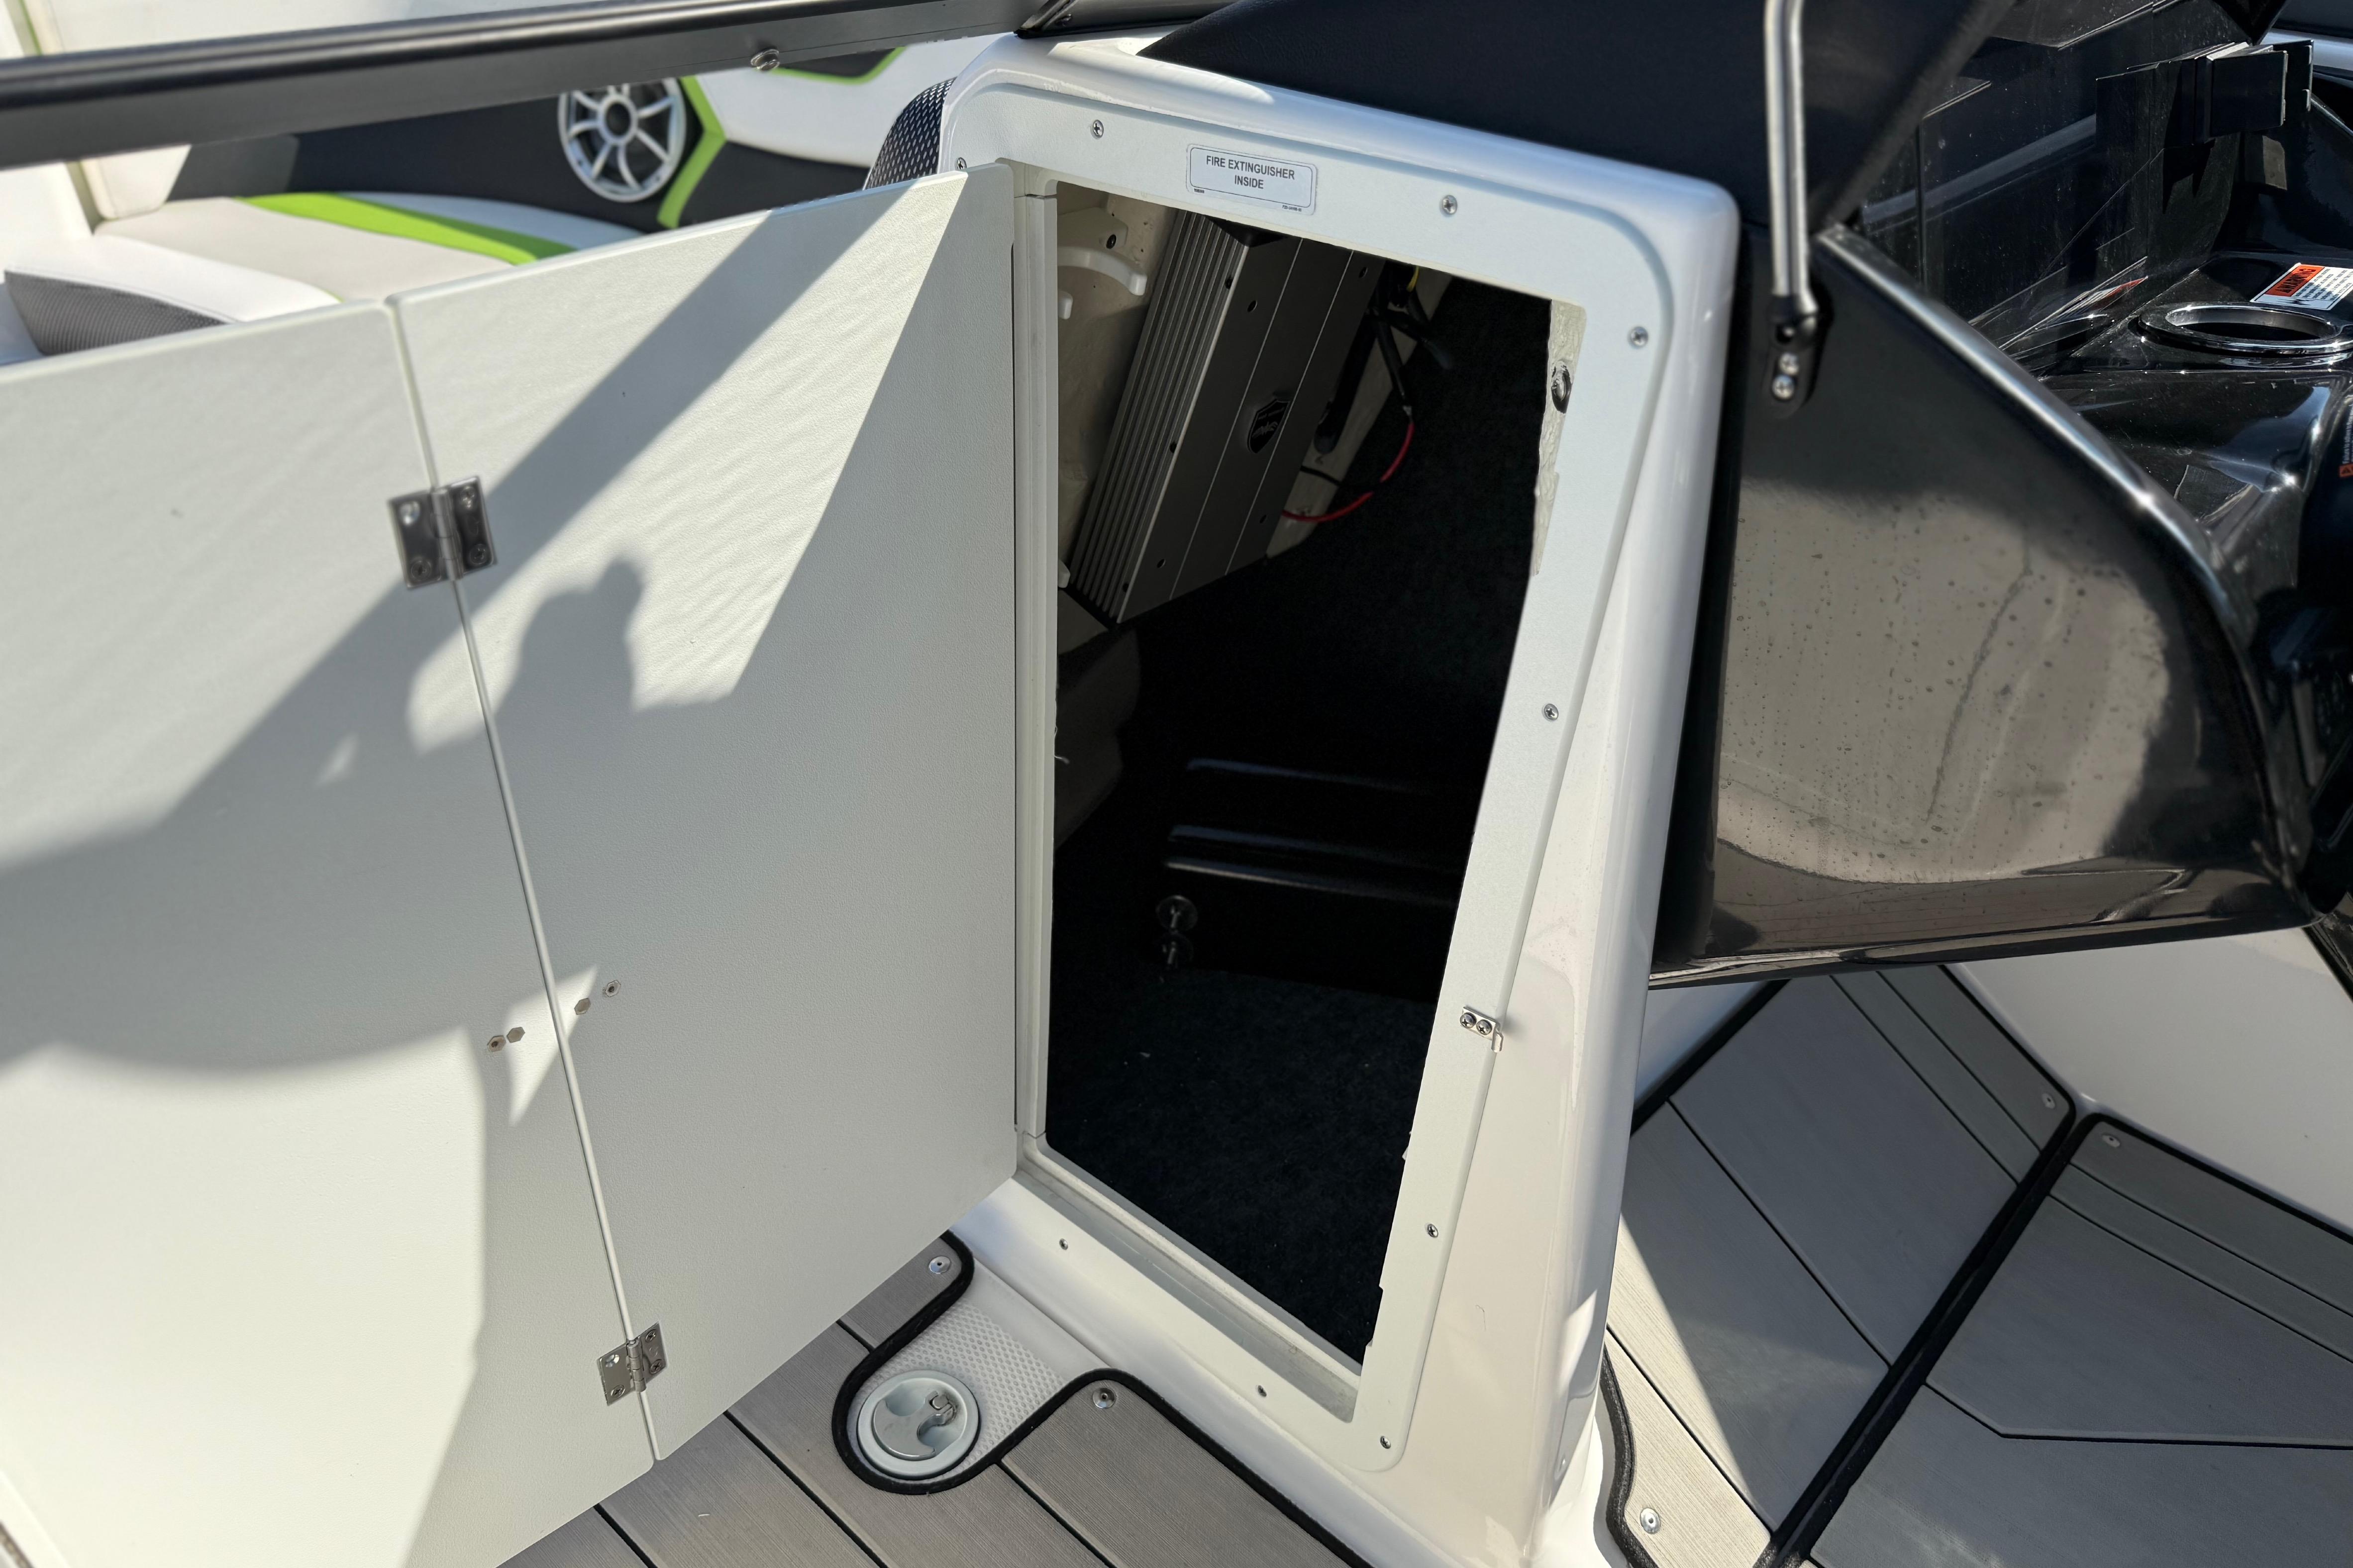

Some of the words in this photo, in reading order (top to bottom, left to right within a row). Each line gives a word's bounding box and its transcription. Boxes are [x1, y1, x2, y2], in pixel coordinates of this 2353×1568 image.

[1206, 155, 1226, 168] FIRE
[1228, 159, 1295, 180] EXTINGUISHER
[1234, 175, 1264, 189] INSIDE
[2276, 268, 2317, 291] WARNING
